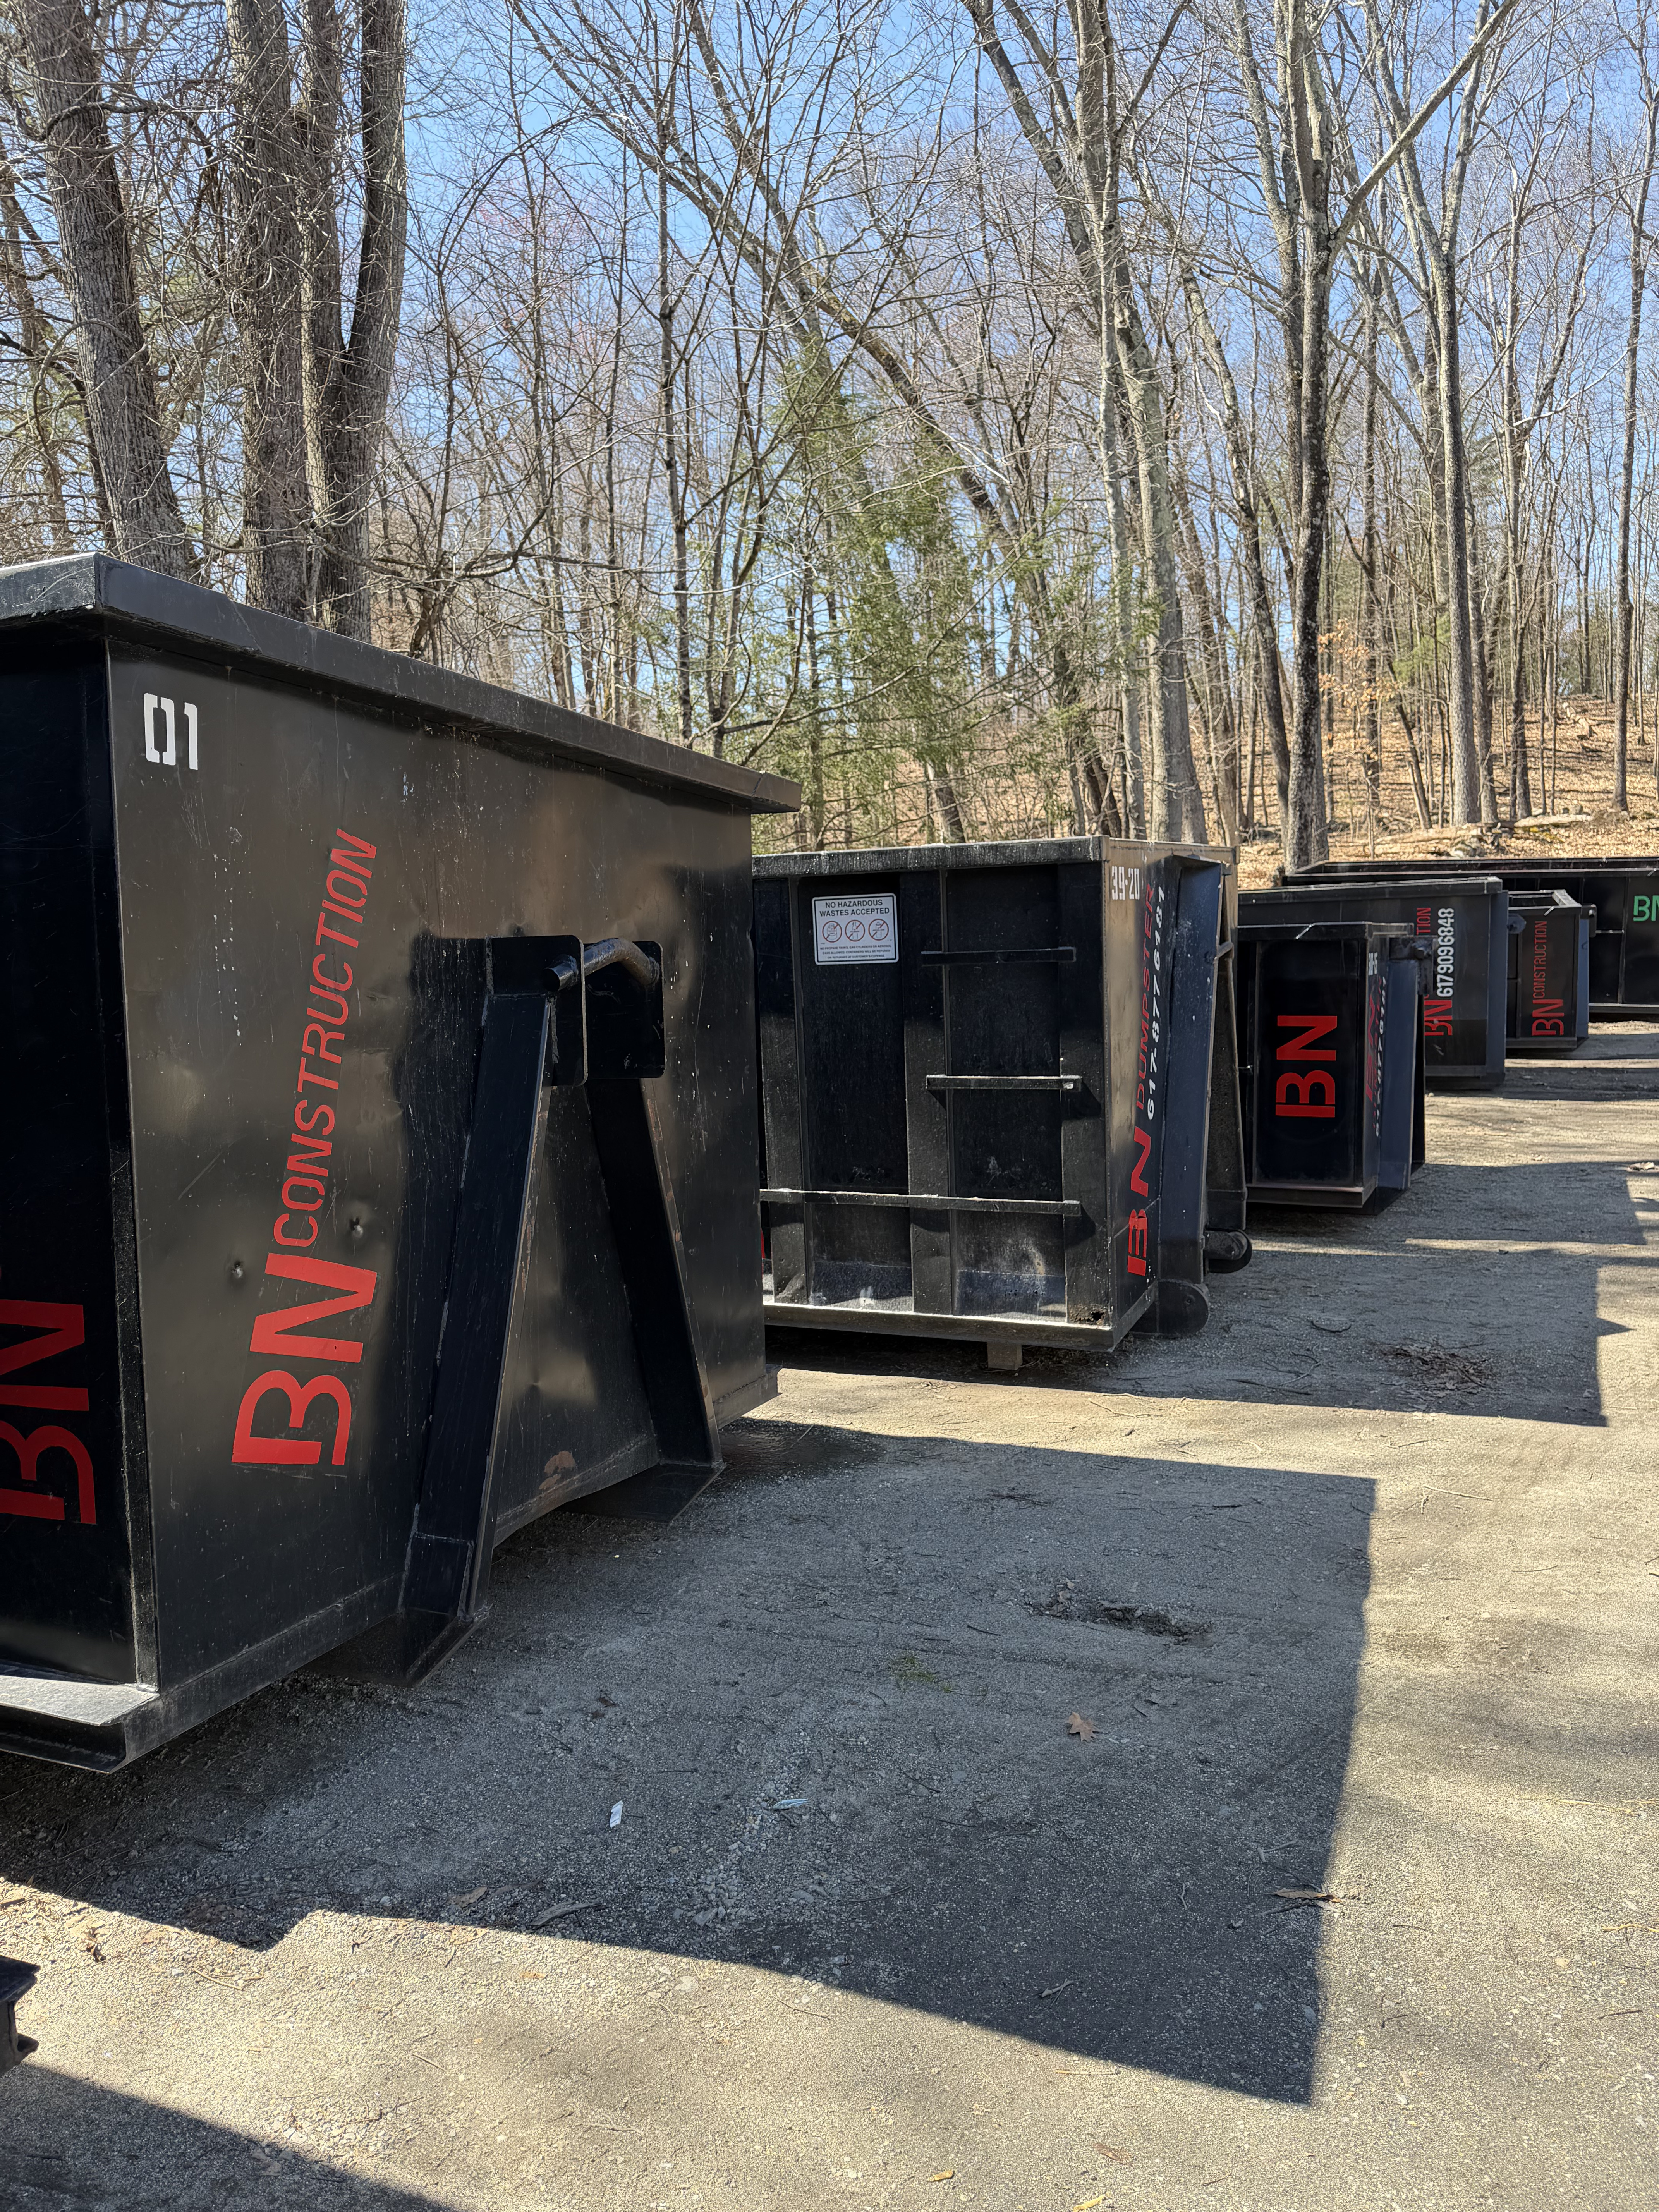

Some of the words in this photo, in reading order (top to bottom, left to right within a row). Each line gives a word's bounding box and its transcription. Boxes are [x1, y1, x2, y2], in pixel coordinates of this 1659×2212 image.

[143, 692, 198, 771] 01
[838, 899, 883, 907] HAZARDOUS
[850, 907, 890, 915] ACCEPTED
[1136, 883, 1154, 1110] DUMPSTER
[1436, 907, 1455, 998] 6179096848
[1533, 920, 1547, 999] CONSTRUCTION
[273, 828, 377, 1247] CONSTRUCTION
[1532, 999, 1565, 1036] BN
[1275, 1015, 1338, 1118] BN
[1127, 1125, 1151, 1277] BN
[231, 1252, 377, 1465] BN
